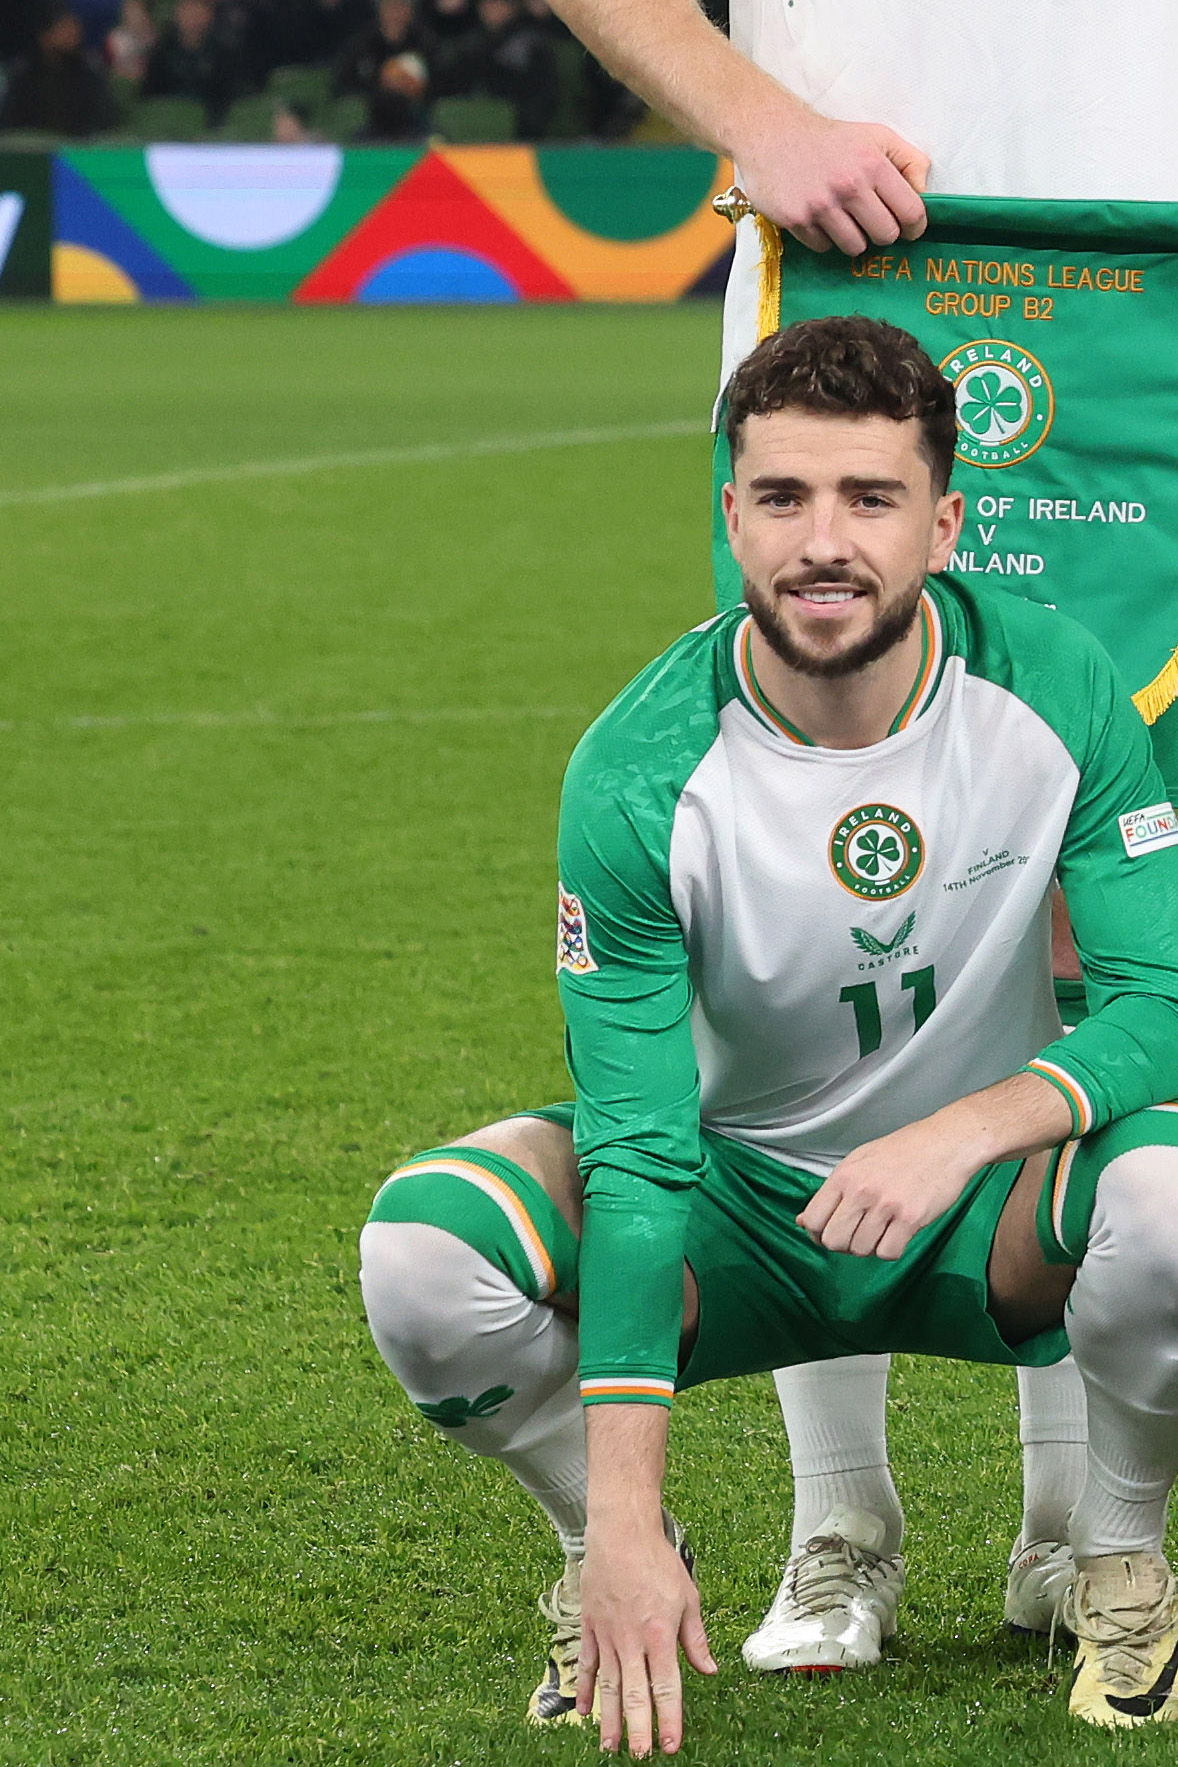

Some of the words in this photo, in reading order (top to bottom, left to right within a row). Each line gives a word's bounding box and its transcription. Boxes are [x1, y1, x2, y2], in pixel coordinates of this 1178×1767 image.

[852, 255, 912, 280] UEFA
[925, 257, 1035, 287] NATIONS
[1047, 264, 1145, 293] LEAGUE
[925, 290, 1011, 319] GROUP
[1023, 297, 1055, 321] B2
[958, 440, 1029, 460] OOTBALL
[976, 495, 1015, 519] OF
[1028, 498, 1147, 524] IRELAND
[977, 523, 997, 546] V
[942, 550, 1045, 576] NLAND
[834, 808, 911, 846] IRELAND
[943, 880, 967, 892] 14TH
[968, 858, 1015, 885] November
[967, 850, 1010, 875] FINLAND
[854, 874, 911, 895] FOOTBALL
[857, 945, 920, 971] CASTORE
[838, 963, 937, 1061] 11
